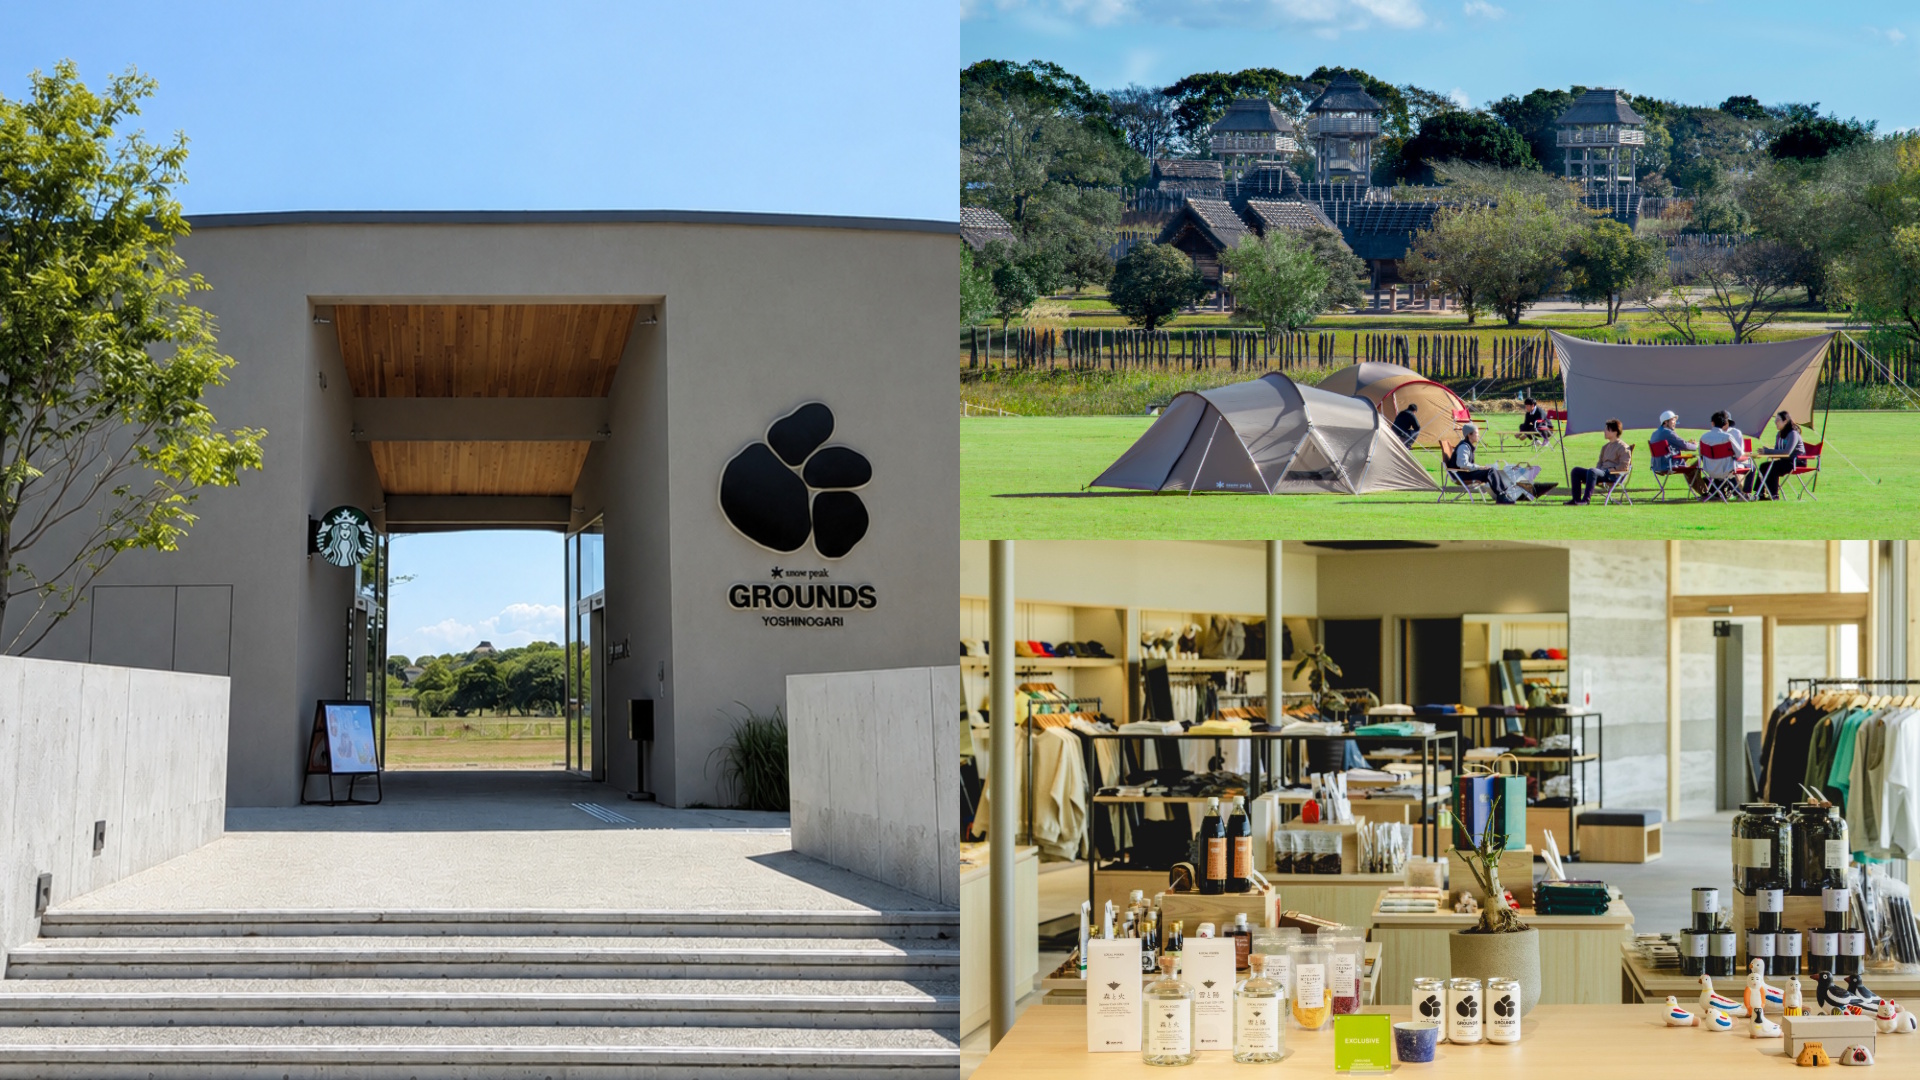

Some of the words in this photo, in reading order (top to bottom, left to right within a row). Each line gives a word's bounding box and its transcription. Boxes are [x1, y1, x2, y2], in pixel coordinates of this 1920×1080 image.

[808, 568, 829, 580] peak
[728, 584, 878, 609] GROUNDS
[762, 616, 844, 627] YOSHINOGARI
